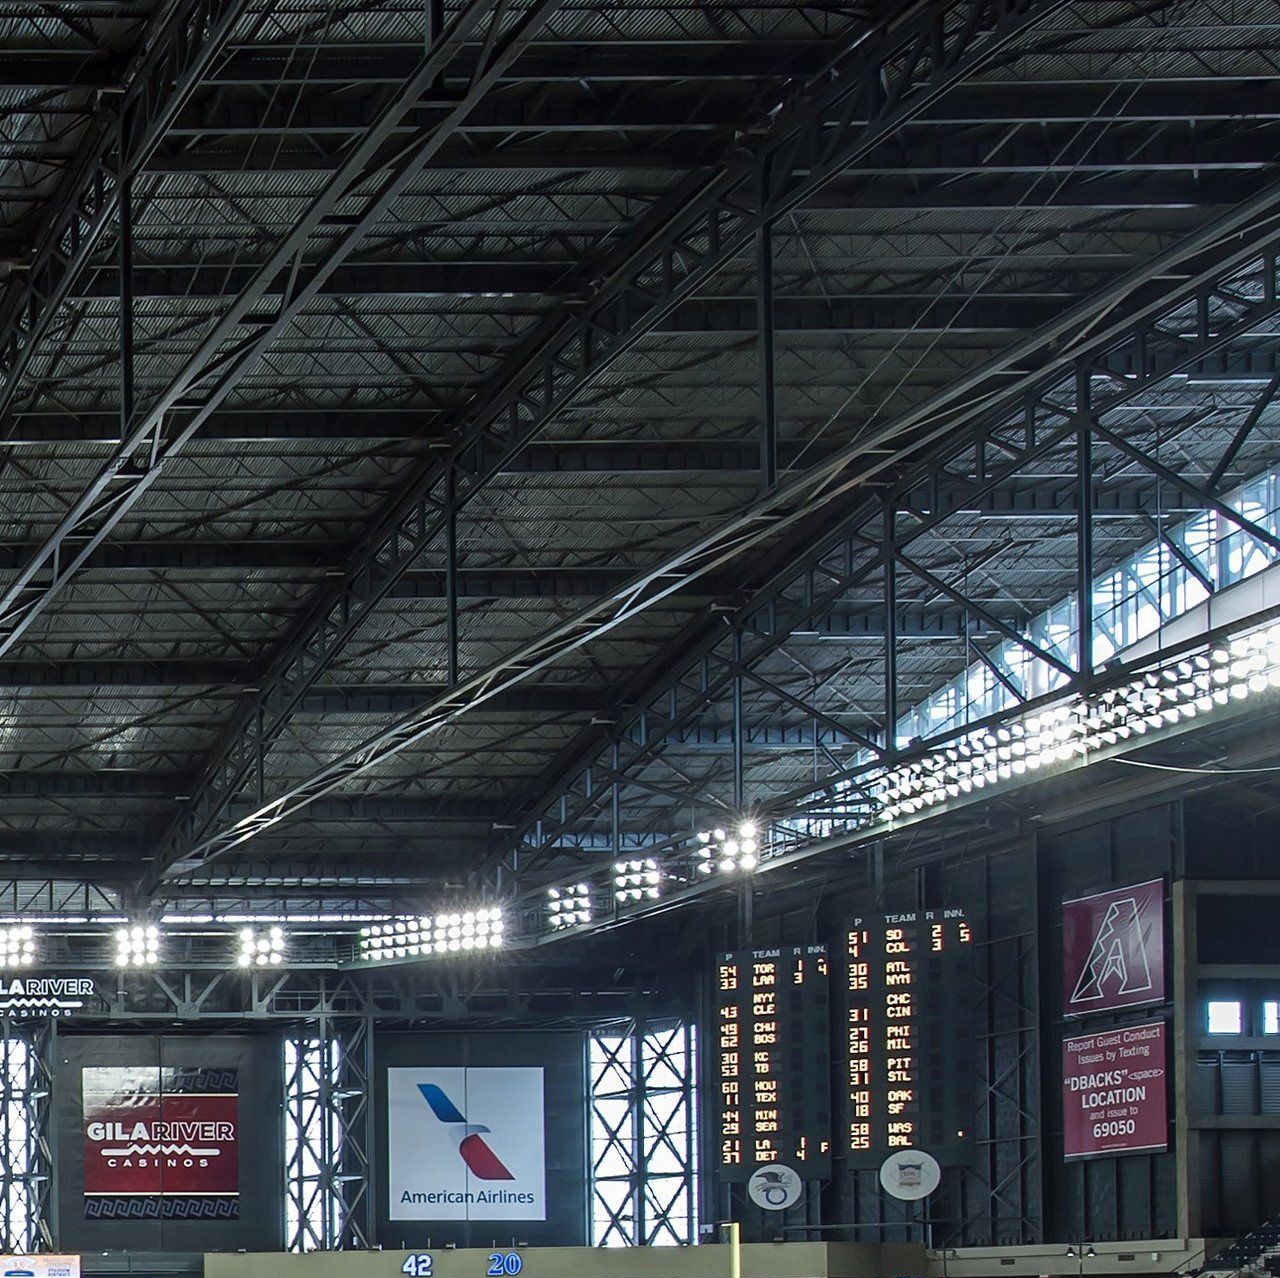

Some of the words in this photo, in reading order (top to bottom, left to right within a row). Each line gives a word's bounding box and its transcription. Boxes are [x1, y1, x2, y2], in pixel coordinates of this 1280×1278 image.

[722, 1082, 738, 1093] 60
[755, 1081, 776, 1091] HOU
[1082, 1086, 1146, 1108] LOCATION
[1093, 1120, 1135, 1137] 69050
[851, 1137, 869, 1149] 25
[889, 1136, 912, 1146] BAL
[107, 1159, 208, 1167] CASINOS
[401, 1189, 476, 1203] American
[477, 1189, 534, 1203] Airlines
[402, 1254, 432, 1276] 42
[487, 1253, 522, 1276] 20
